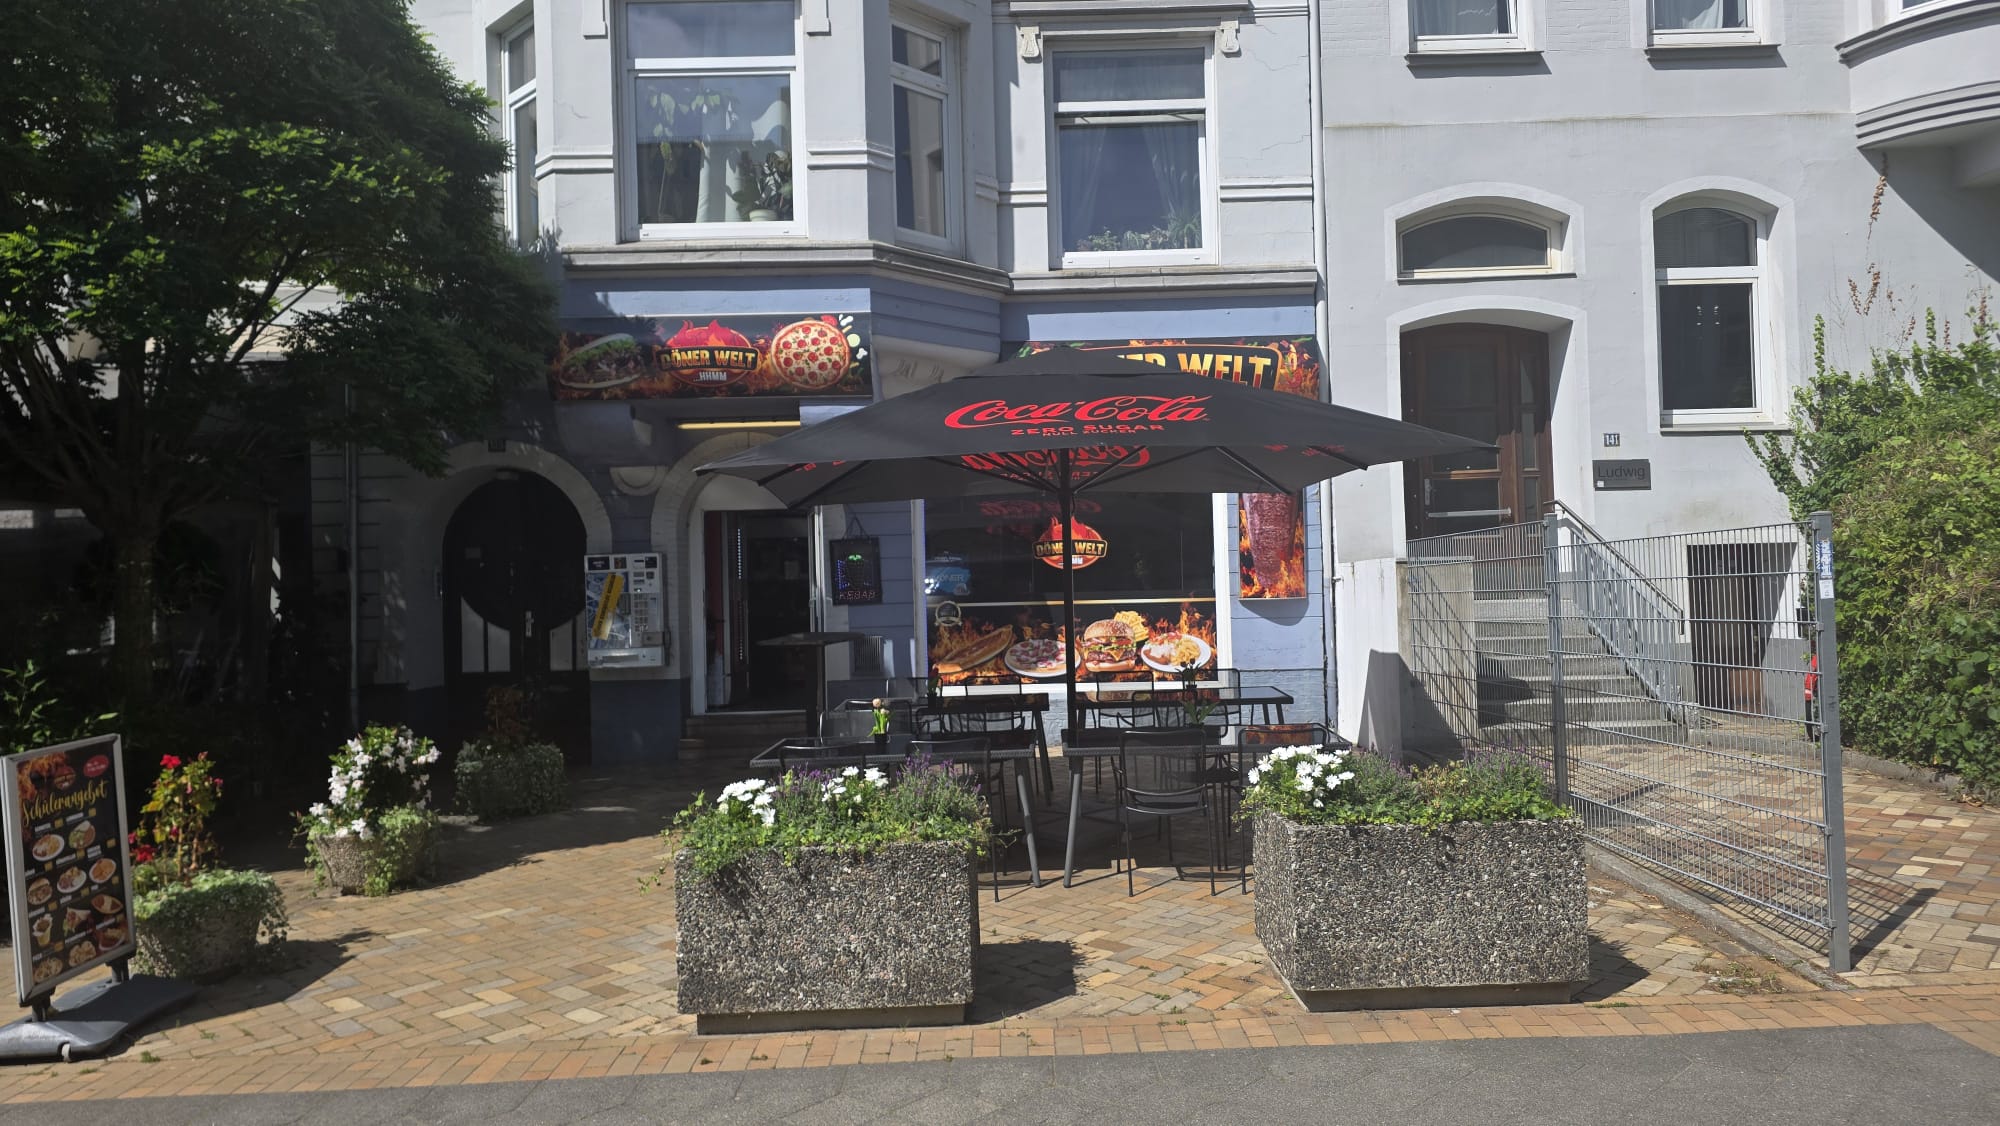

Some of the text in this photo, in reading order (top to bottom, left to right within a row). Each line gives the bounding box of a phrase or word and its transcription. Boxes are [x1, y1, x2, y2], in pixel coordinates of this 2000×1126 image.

[661, 349, 755, 369] DÖNER WELT
[1177, 353, 1271, 389] WELT
[944, 395, 1213, 429] Coca-Cola
[1011, 426, 1074, 436] ZERO
[1606, 434, 1619, 446] 141
[1598, 465, 1645, 481] Ludwig
[1035, 541, 1104, 556] DÖNE WELT
[23, 780, 108, 827] Schülerangebot
